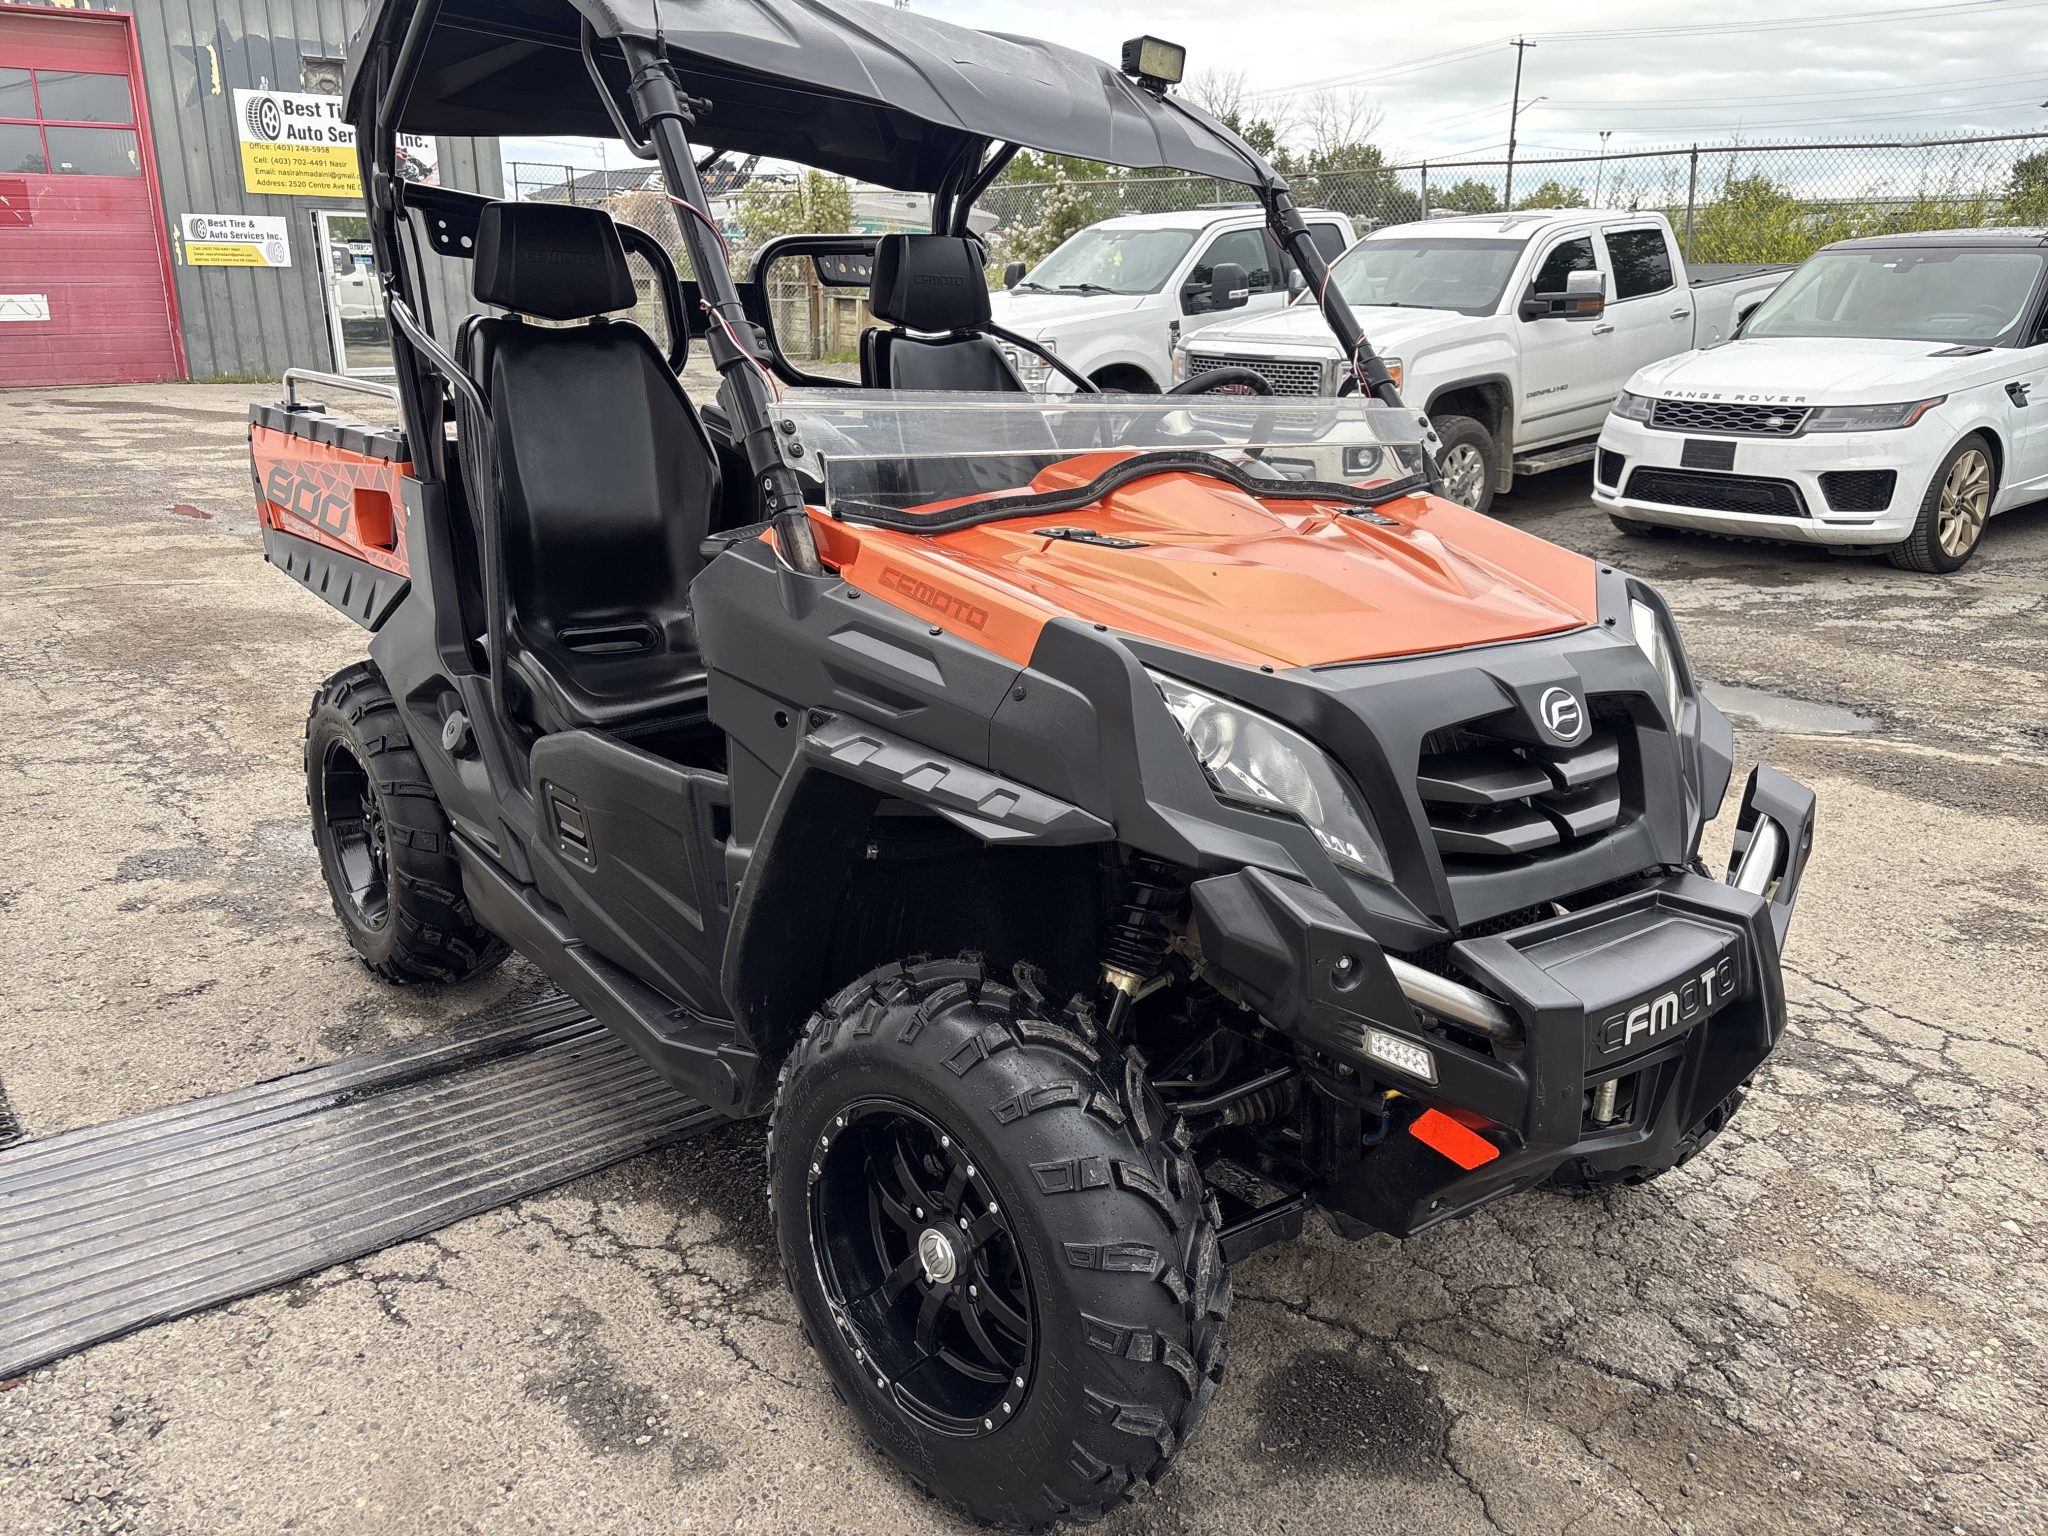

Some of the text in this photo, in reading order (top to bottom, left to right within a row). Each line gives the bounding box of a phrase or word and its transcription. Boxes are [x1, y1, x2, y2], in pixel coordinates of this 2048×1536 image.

[283, 99, 322, 118] Best
[287, 124, 323, 142] Auto
[400, 133, 429, 148] Inc.
[249, 142, 330, 154] Office: (403) 248-5958
[253, 156, 347, 168] Cell: (403) 702-4491 Nasir
[255, 167, 276, 175] Email:
[256, 179, 287, 187] Address:
[288, 180, 307, 188] 2520
[308, 181, 331, 189] Centre
[332, 182, 345, 190] Ave
[346, 183, 356, 191] NE
[207, 219, 255, 228] Best Tire &
[209, 230, 282, 241] Auto Services Inc.
[1663, 390, 1807, 403] RANGE ROVER
[266, 465, 351, 538] 800
[1597, 955, 1736, 1055] CFMOTO
